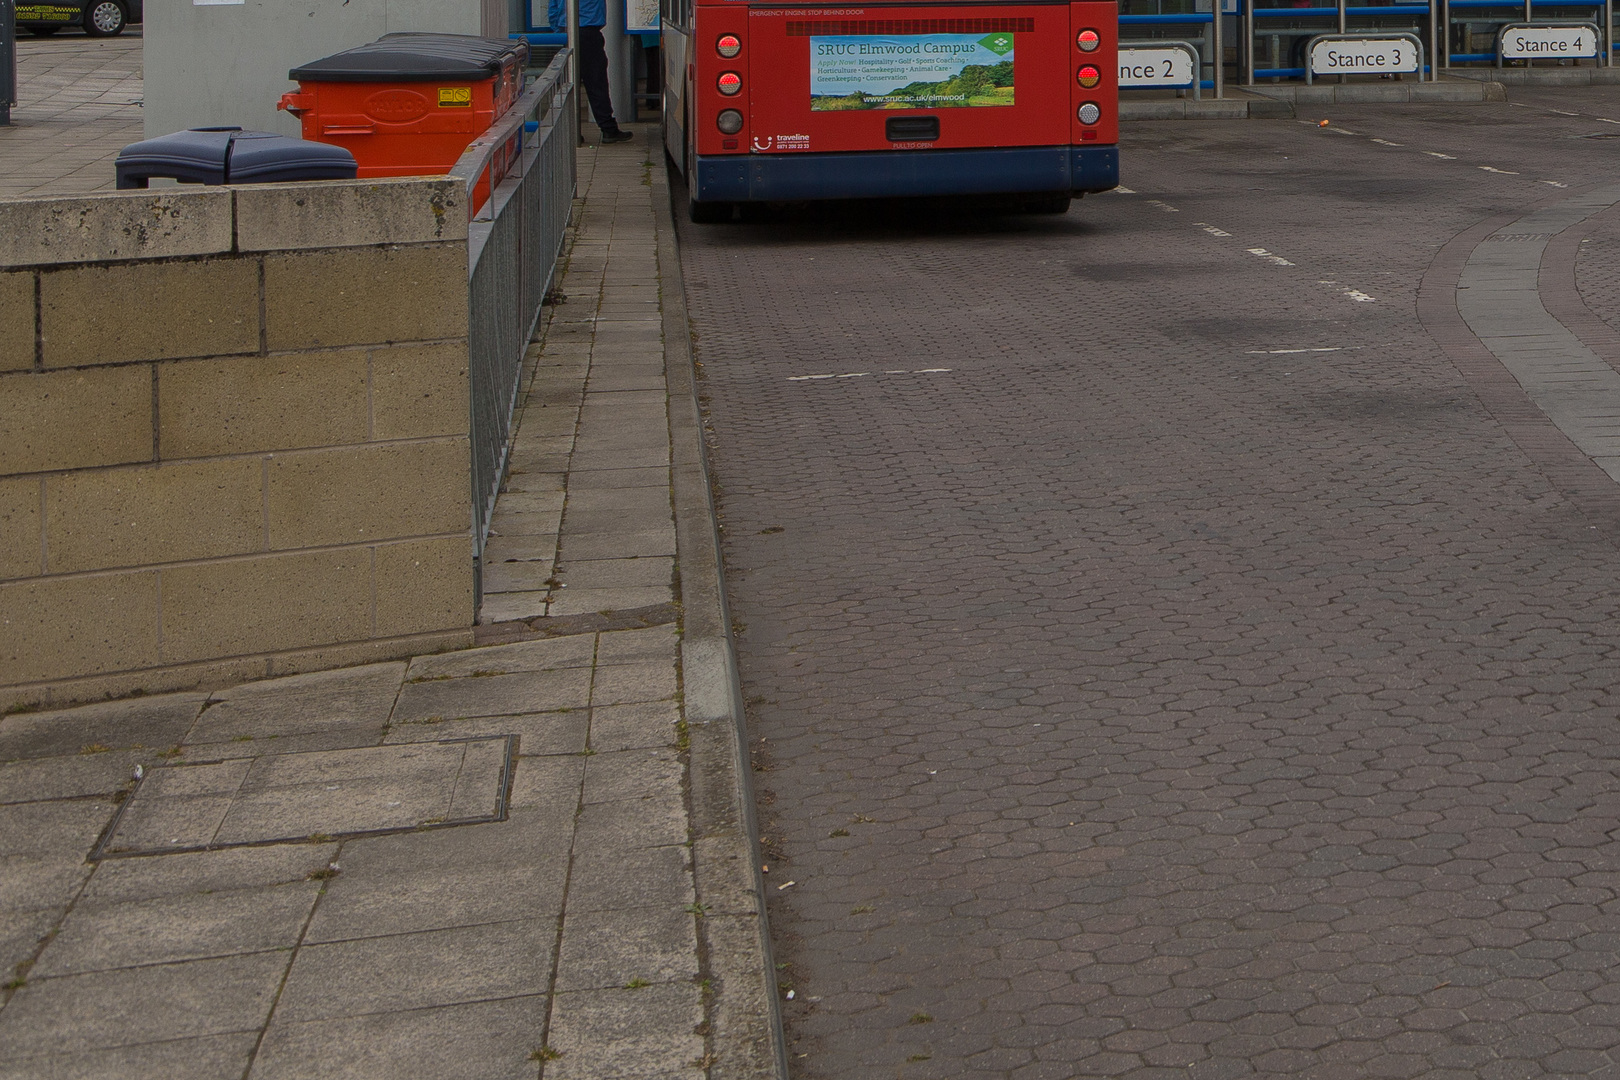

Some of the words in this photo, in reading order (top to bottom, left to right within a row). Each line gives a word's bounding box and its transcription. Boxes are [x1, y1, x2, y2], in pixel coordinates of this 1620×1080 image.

[817, 44, 856, 56] SRUC
[858, 43, 921, 55] Elmwood
[923, 42, 976, 56] Campus
[1516, 37, 1568, 52] Stance
[1573, 36, 1583, 52] 4
[858, 58, 895, 67] Hospitality
[936, 57, 966, 65] Coaching
[1327, 50, 1386, 68] Stance
[1392, 48, 1402, 66] 3
[861, 66, 905, 74] Gamekeeping
[1162, 59, 1175, 78] 2
[817, 75, 862, 83] Greenkeeping
[862, 93, 965, 103] www.sruc.ac.uk/elmwood
